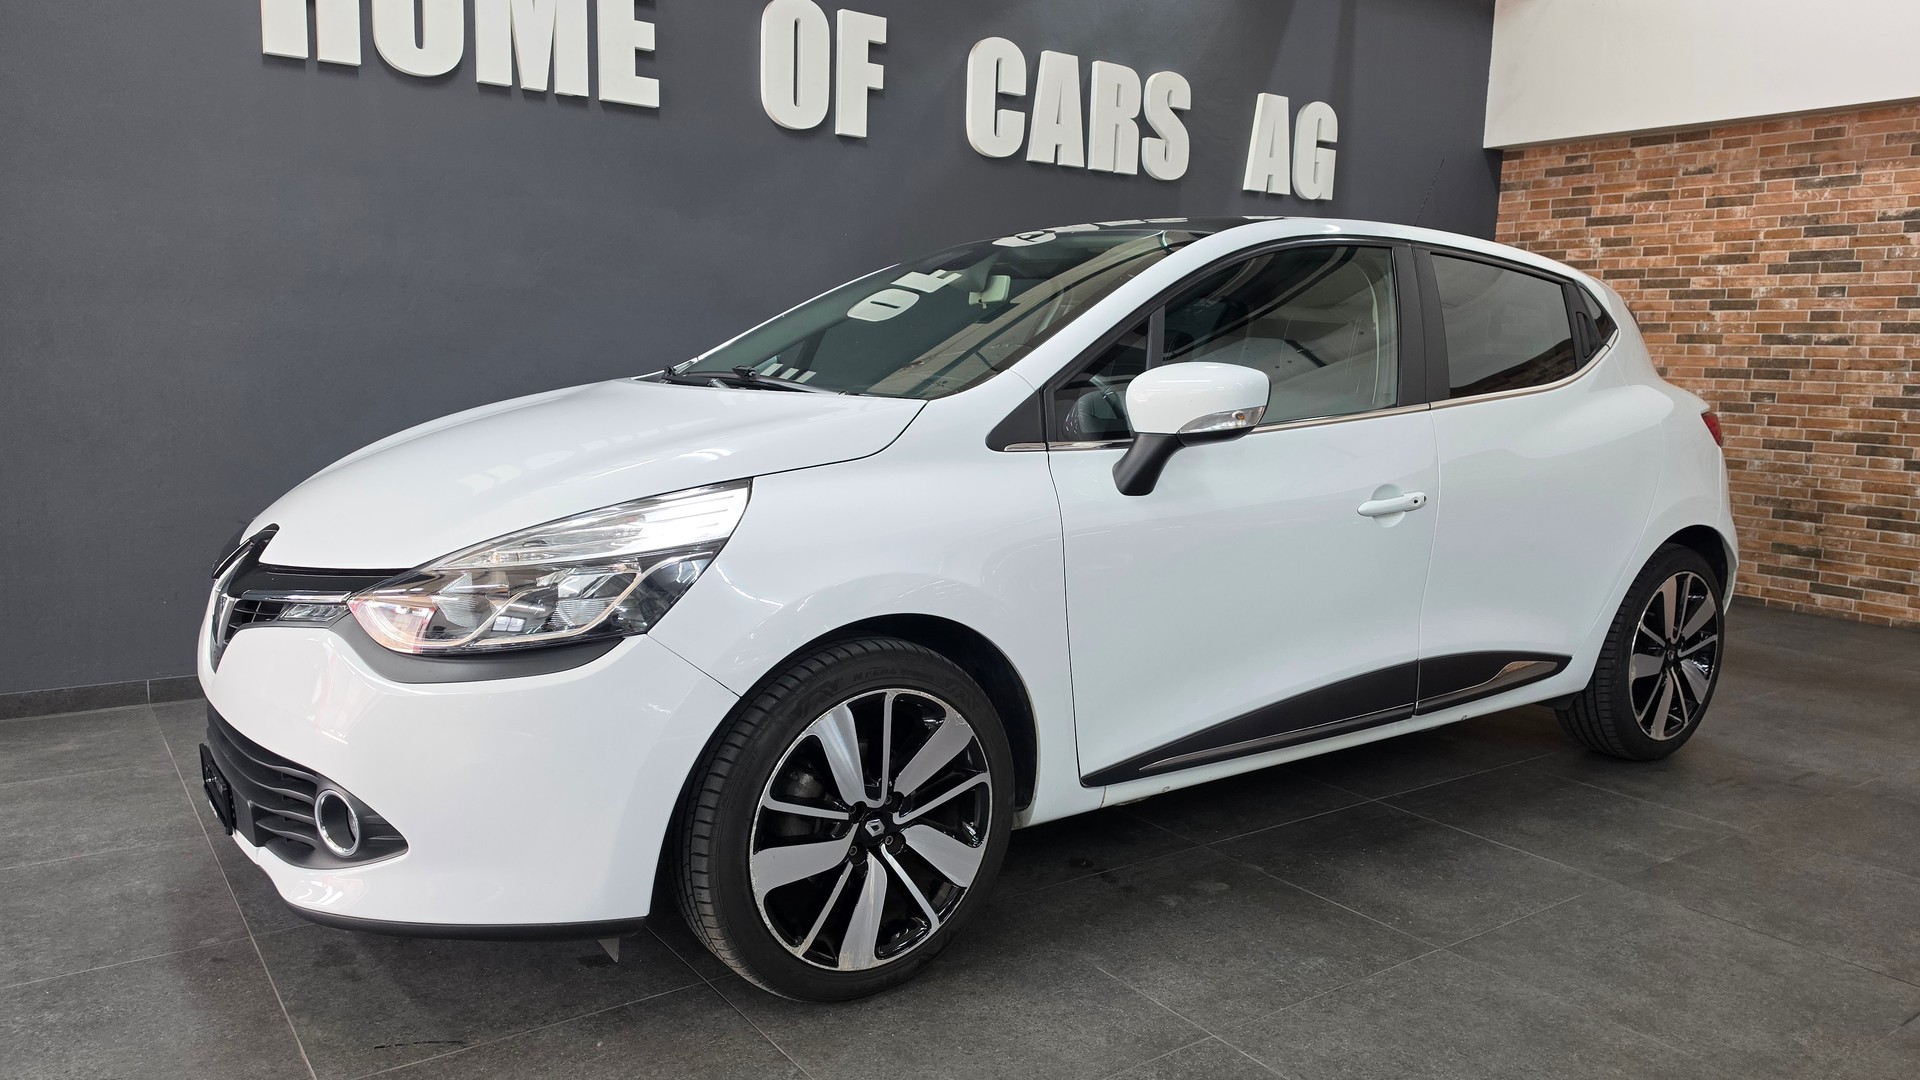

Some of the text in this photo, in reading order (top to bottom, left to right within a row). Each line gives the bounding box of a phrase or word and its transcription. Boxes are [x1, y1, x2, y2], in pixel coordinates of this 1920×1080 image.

[760, 0, 887, 138] OF
[966, 36, 1191, 181] CARS
[1242, 92, 1338, 200] AG
